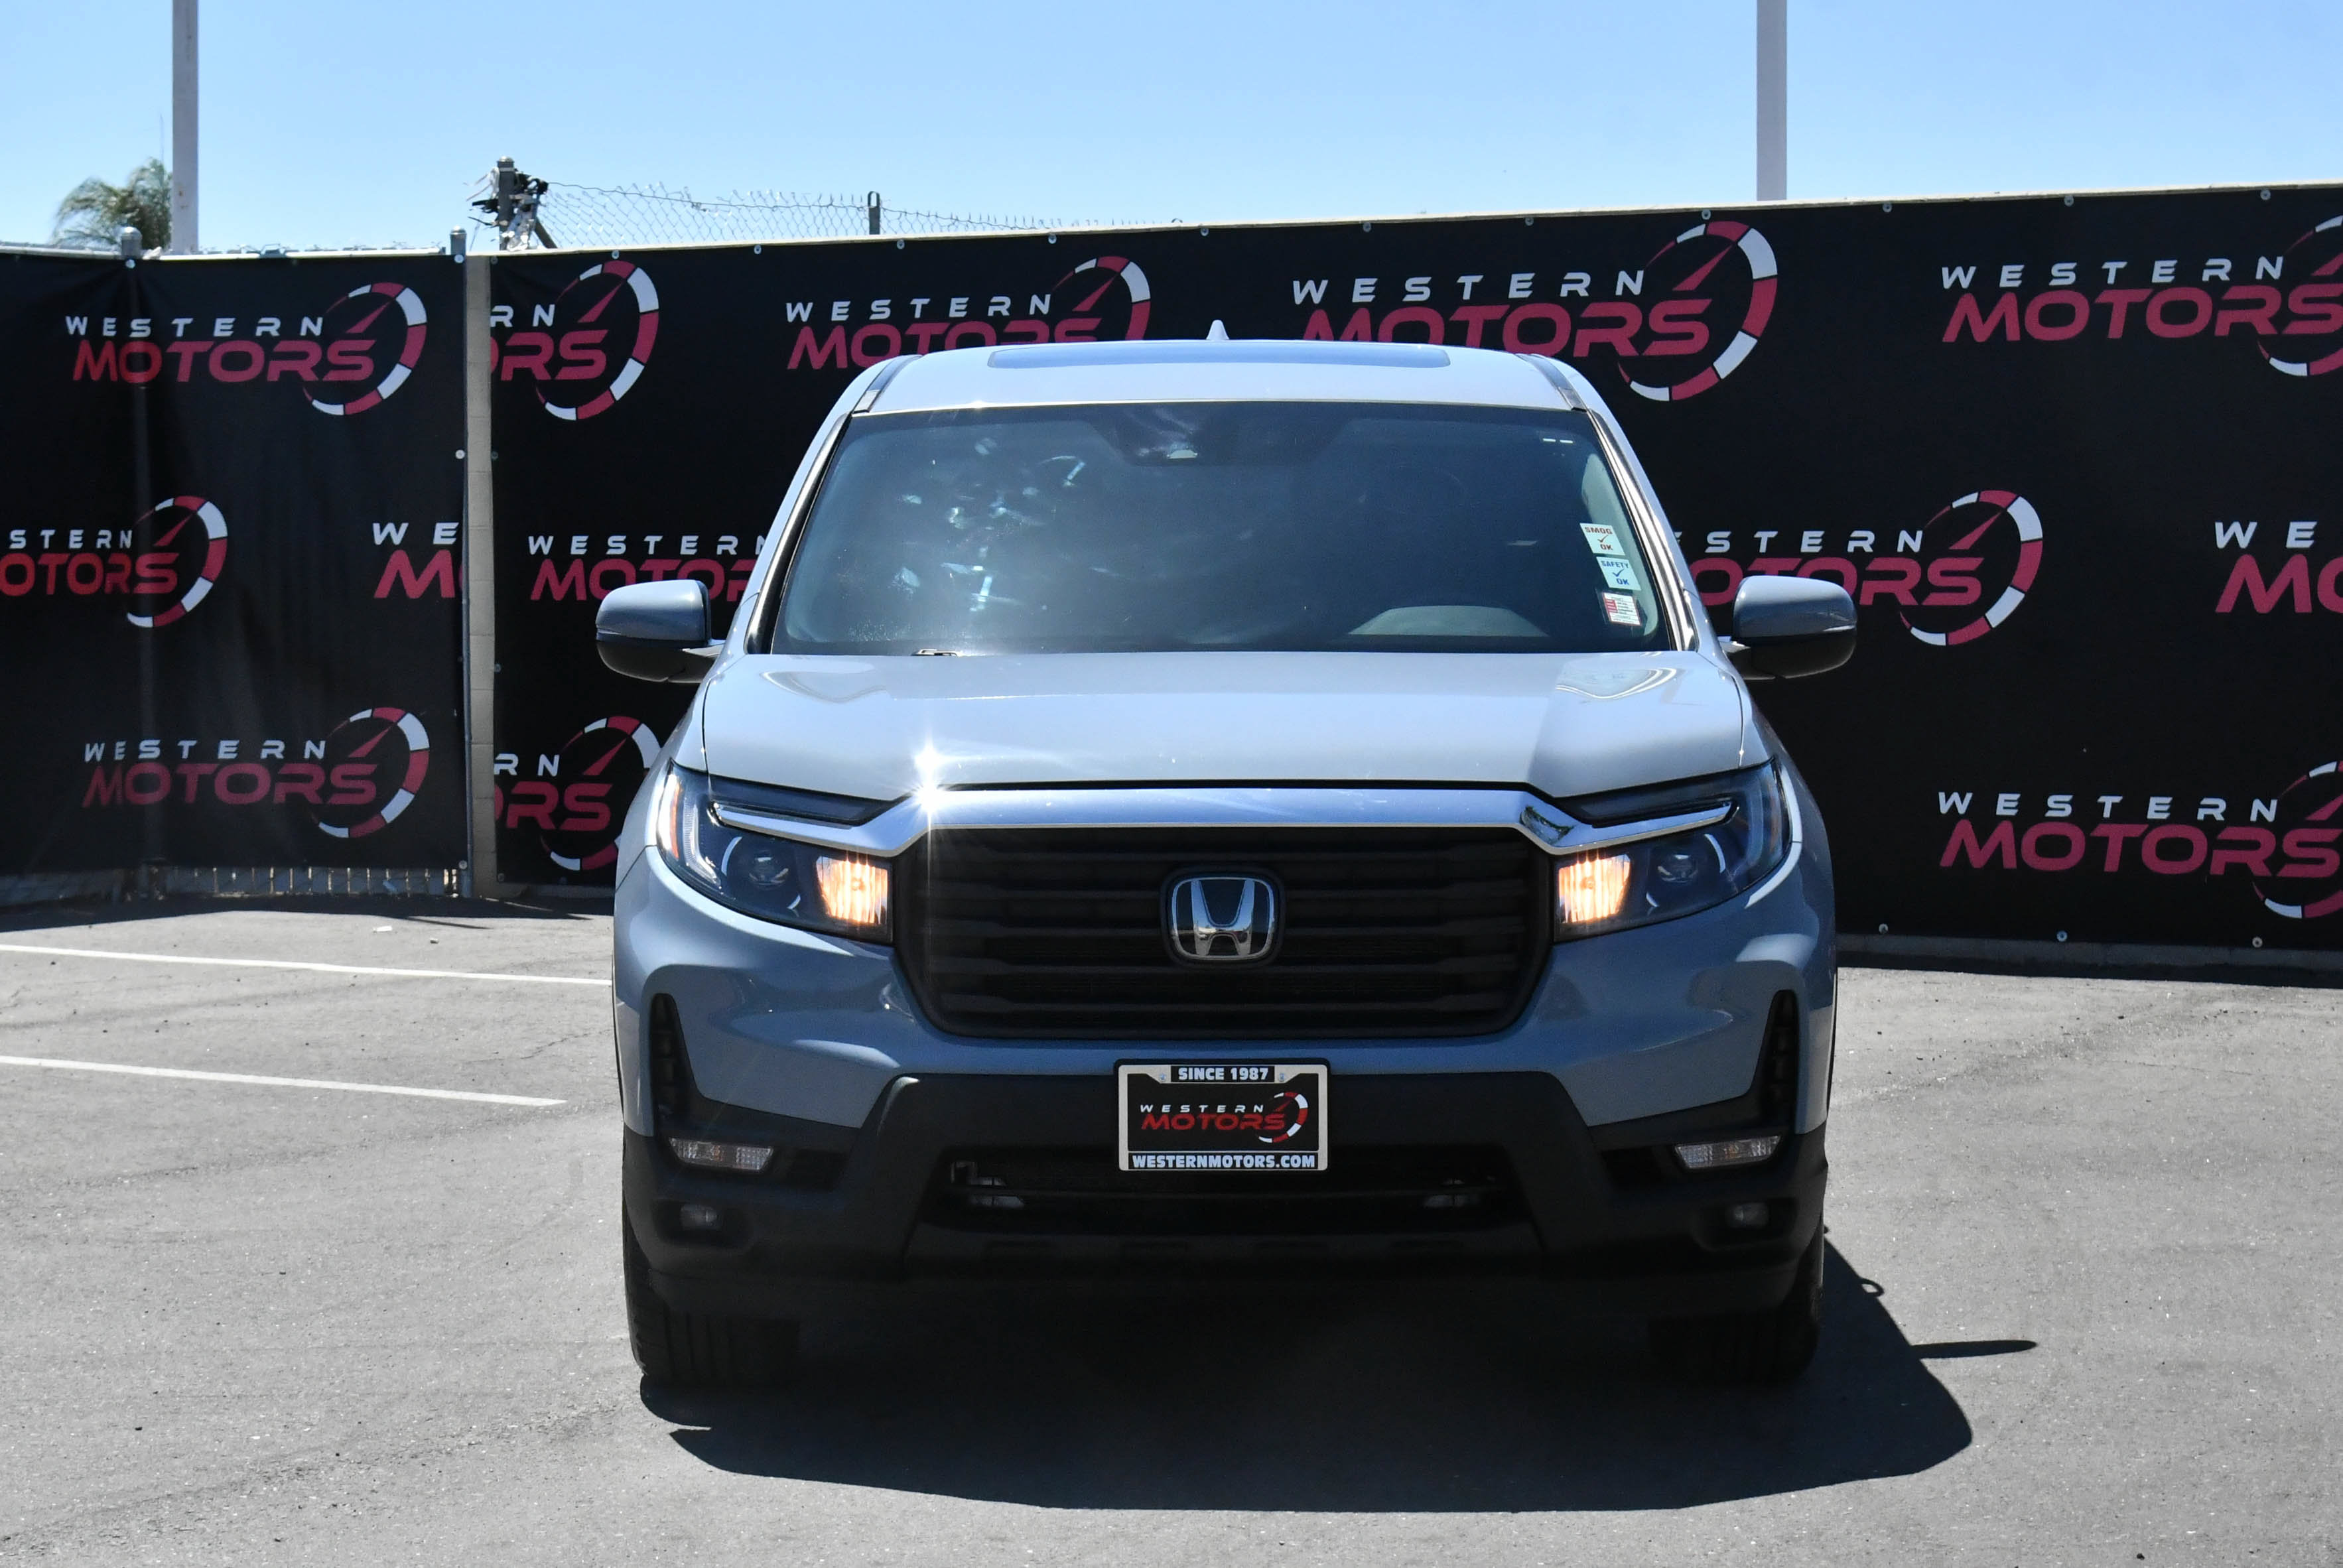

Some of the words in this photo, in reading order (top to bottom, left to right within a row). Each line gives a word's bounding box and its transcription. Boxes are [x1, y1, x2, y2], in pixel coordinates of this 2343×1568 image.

[1293, 270, 1644, 304] WESTERN
[1943, 257, 2284, 289] WESTERN
[786, 294, 1051, 322] WESTERN
[1942, 283, 2343, 343] MOTORS
[66, 316, 324, 338] WESTERN
[73, 340, 376, 383] MOTORS
[1674, 531, 1924, 553] STERN
[84, 740, 326, 762] WESTERN
[82, 763, 377, 808] MOTORS
[1938, 792, 2277, 822] WESTERN
[1940, 819, 2343, 878] MOTORS
[1178, 1067, 1225, 1080] SINCE
[1230, 1067, 1269, 1080] 1987
[1140, 1104, 1264, 1113] WESTERN
[1141, 1114, 1286, 1131] MOTORS
[1132, 1155, 1315, 1168] WESTERNMOTORS.COM
